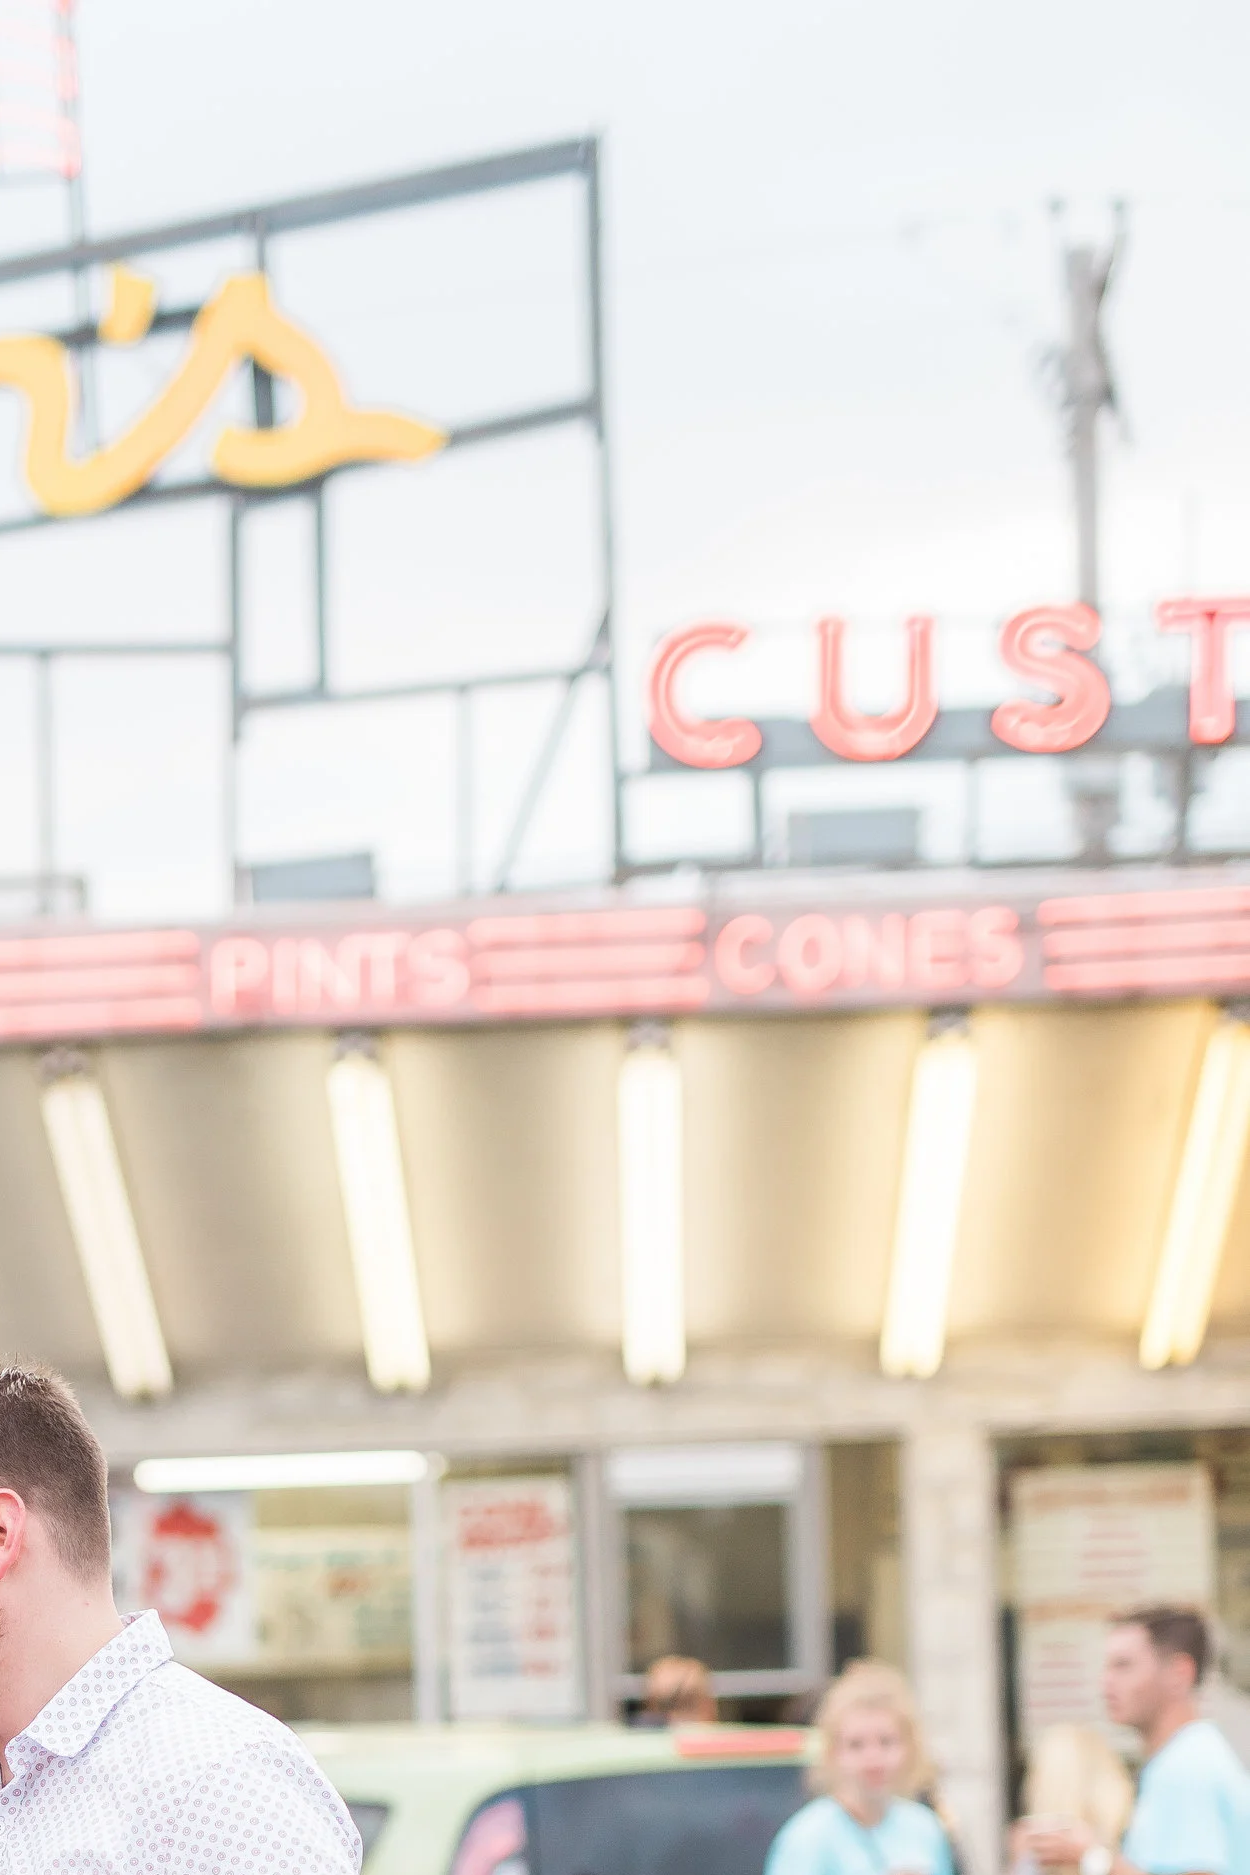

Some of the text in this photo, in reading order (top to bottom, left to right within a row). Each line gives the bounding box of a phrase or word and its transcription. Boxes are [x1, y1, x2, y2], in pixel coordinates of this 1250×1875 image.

[647, 594, 1250, 769] CUST
[210, 927, 473, 1018] PINTS
[713, 904, 1025, 997] CONES
